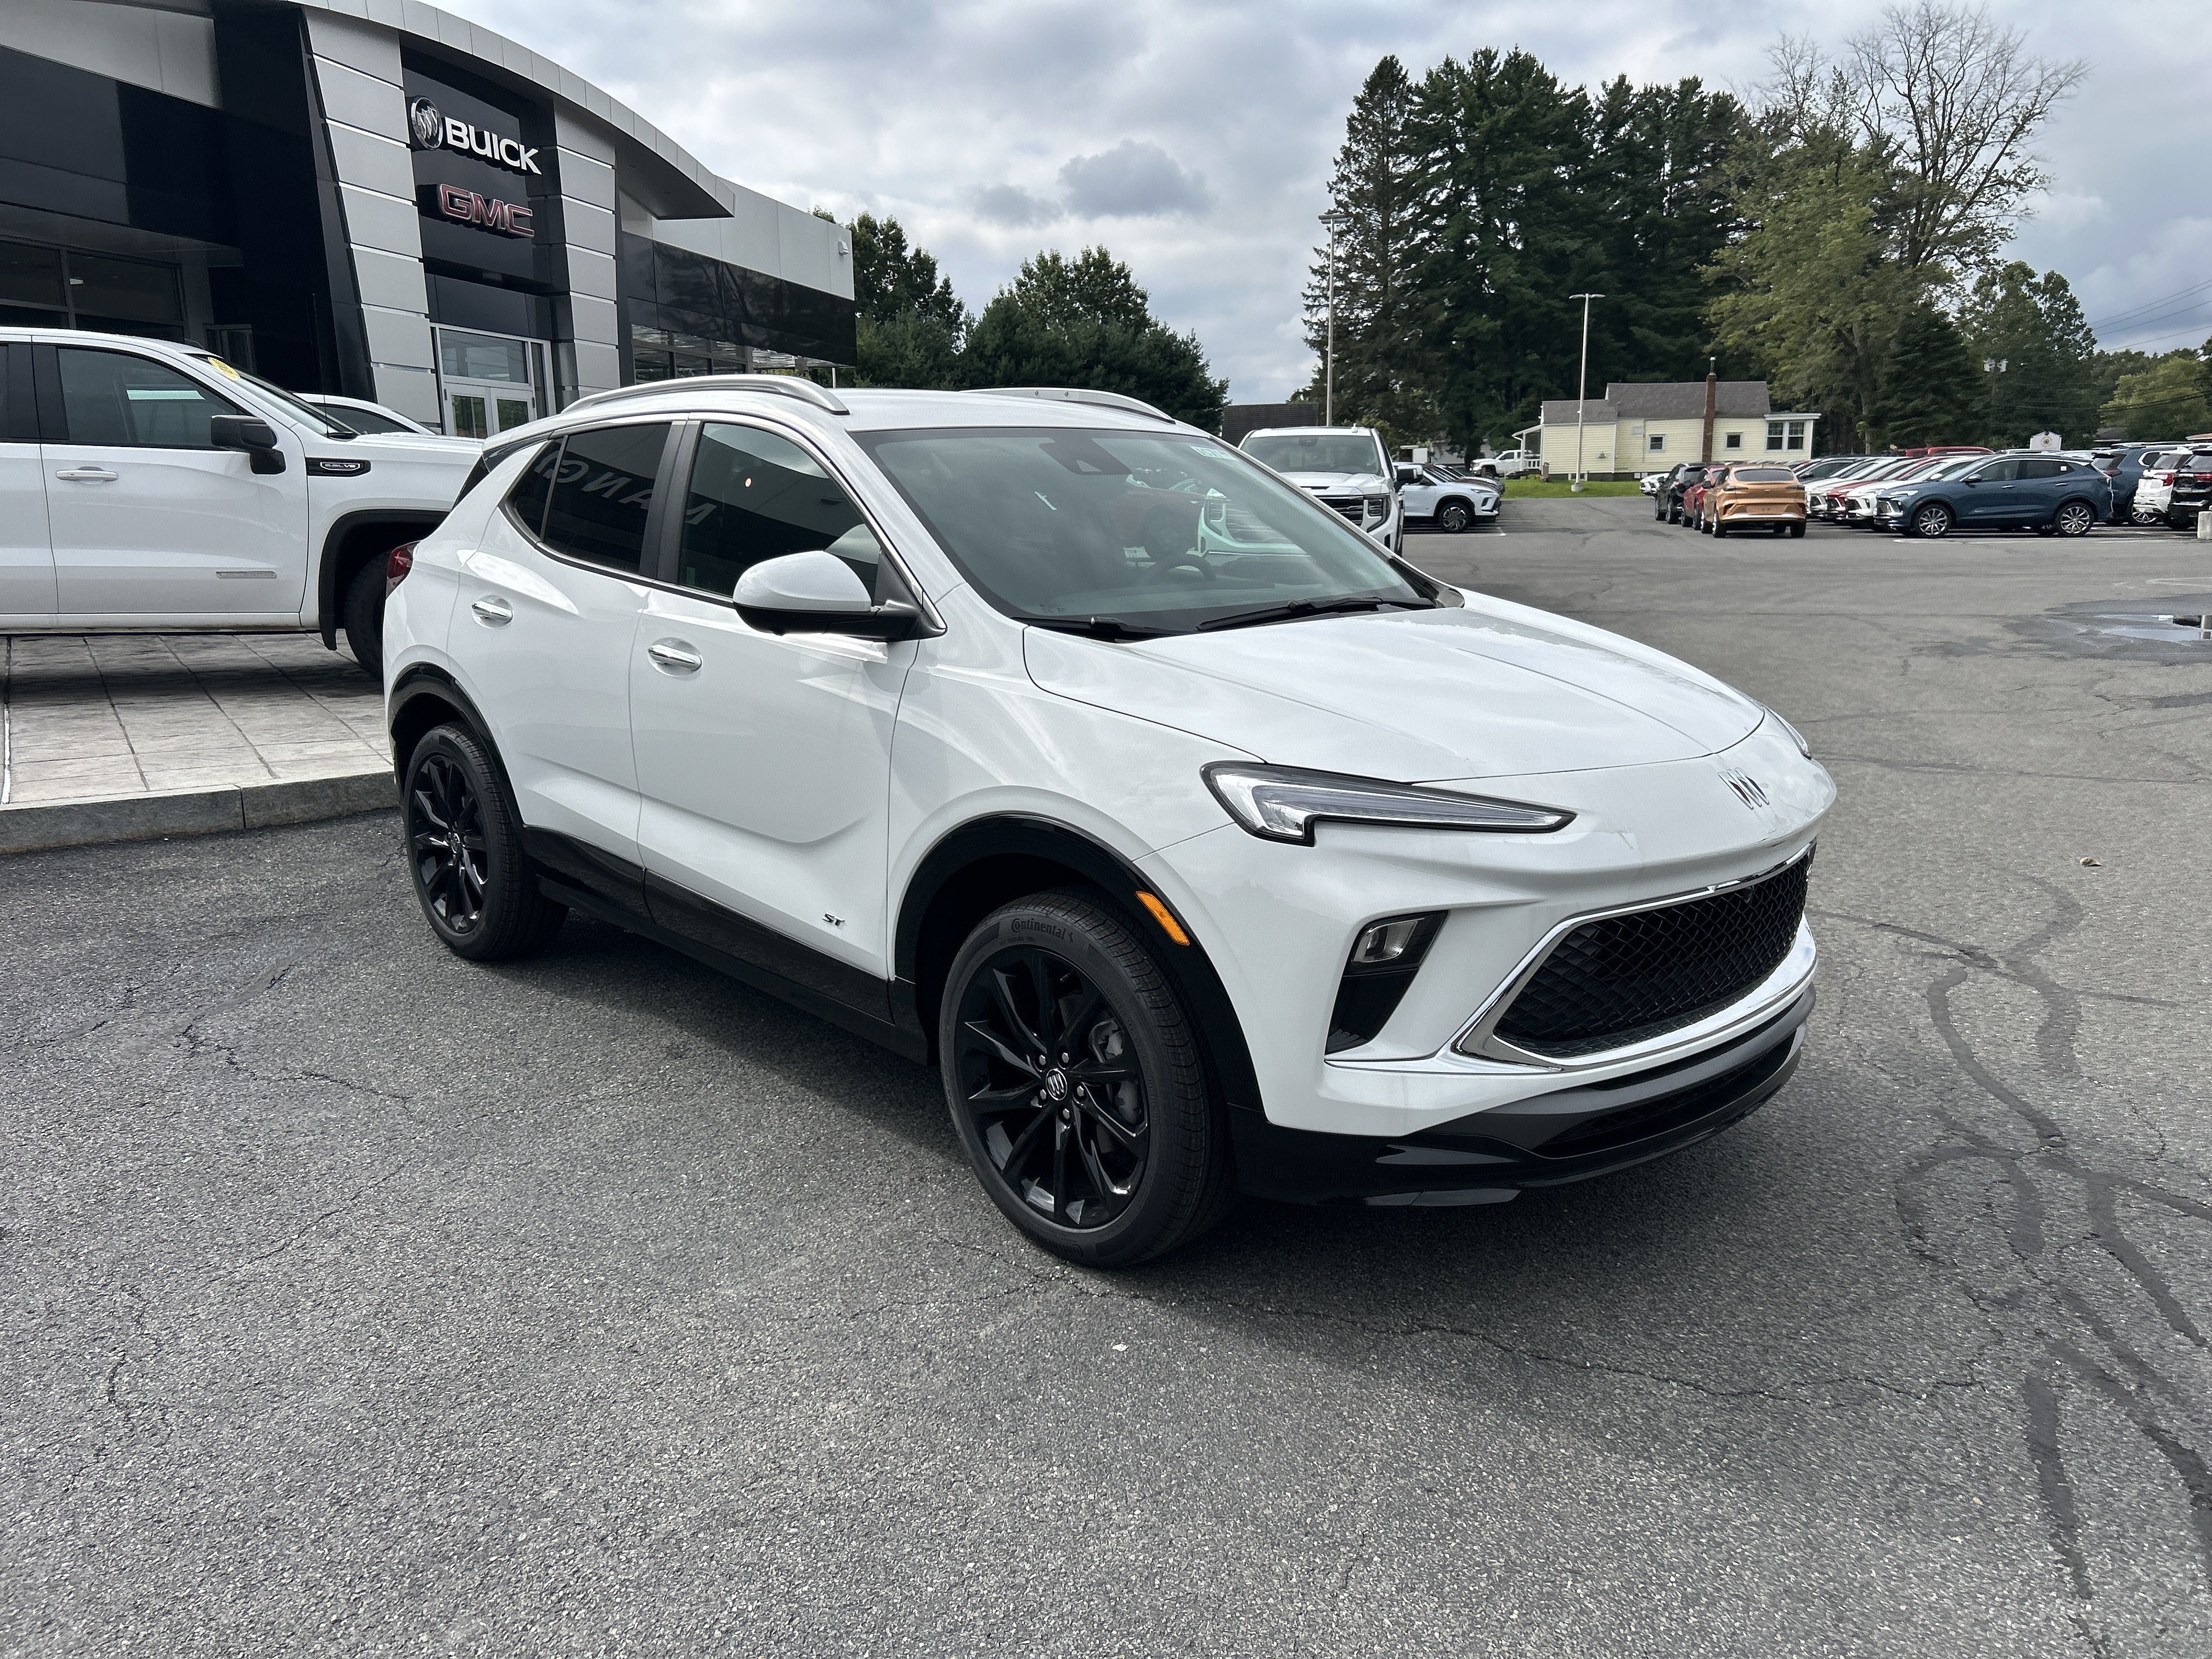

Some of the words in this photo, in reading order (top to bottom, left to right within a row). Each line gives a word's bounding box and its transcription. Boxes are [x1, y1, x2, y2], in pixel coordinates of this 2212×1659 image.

[445, 116, 542, 175] BUICK
[439, 183, 535, 238] GMC
[822, 912, 845, 927] ST
[1011, 918, 1067, 940] Continental
